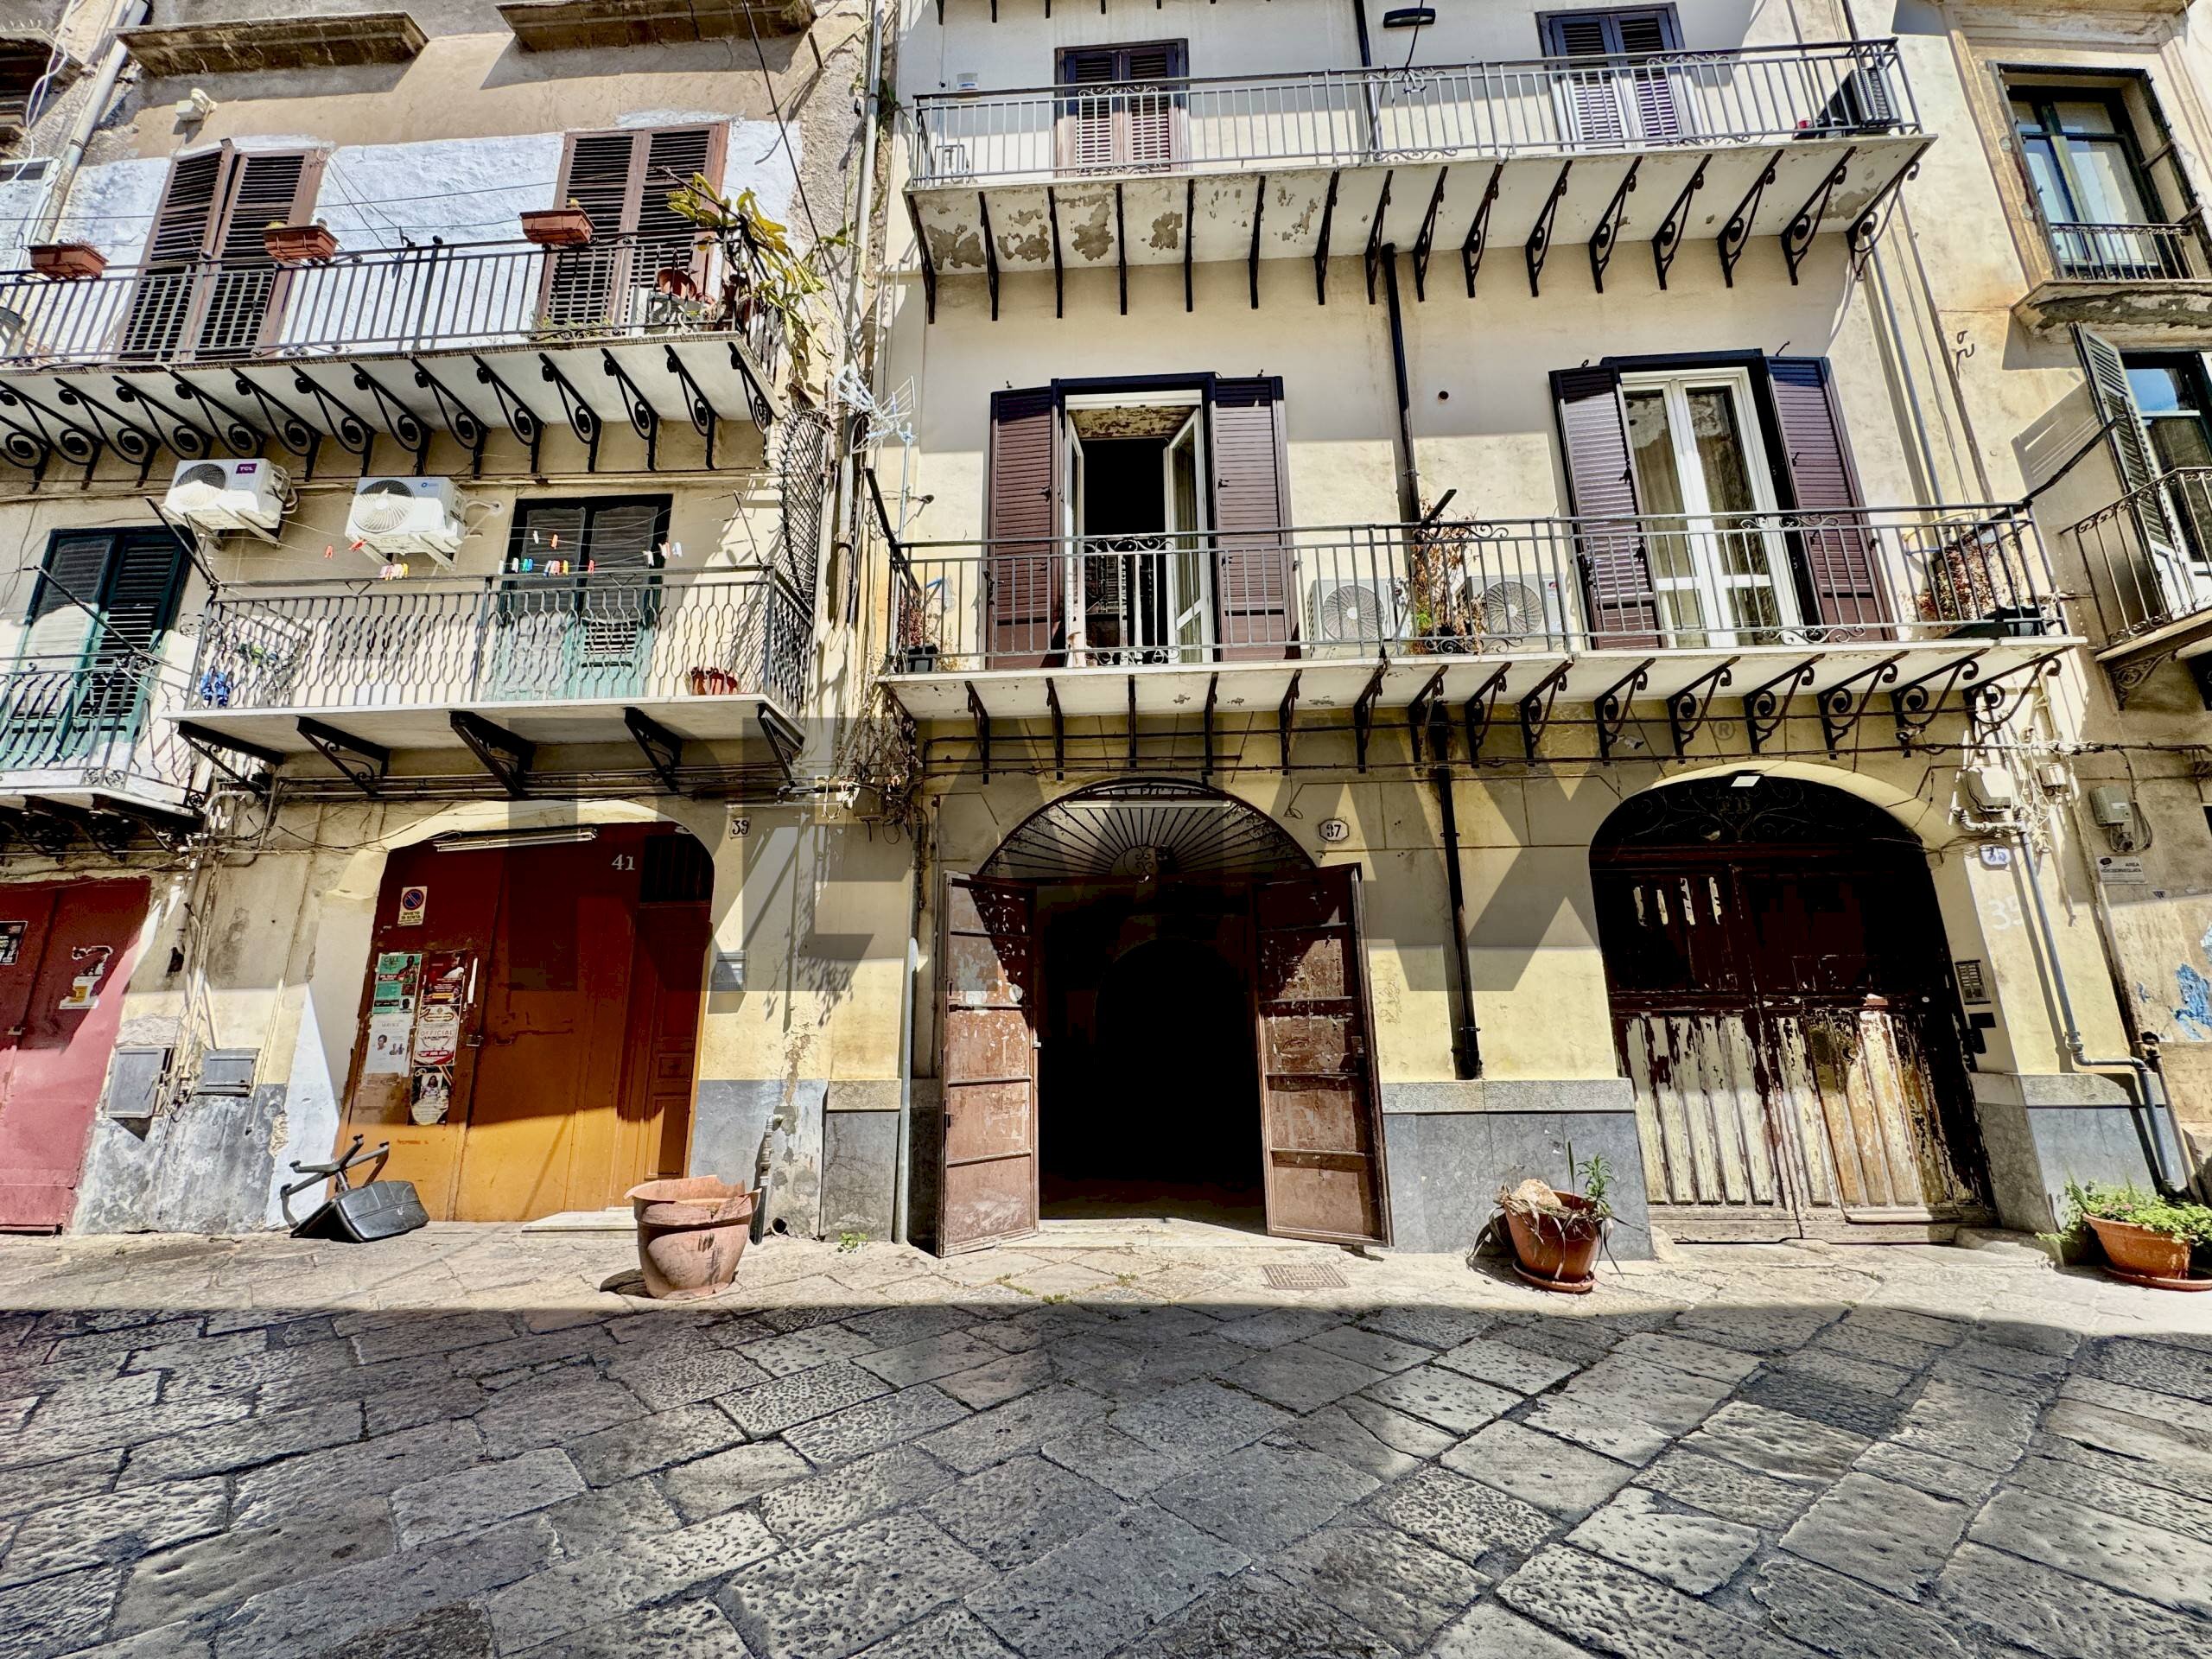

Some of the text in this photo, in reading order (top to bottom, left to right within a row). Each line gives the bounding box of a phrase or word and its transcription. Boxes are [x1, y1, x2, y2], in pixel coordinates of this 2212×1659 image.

[732, 820, 749, 835] 39
[1326, 823, 1341, 837] 37
[611, 854, 636, 871] 41
